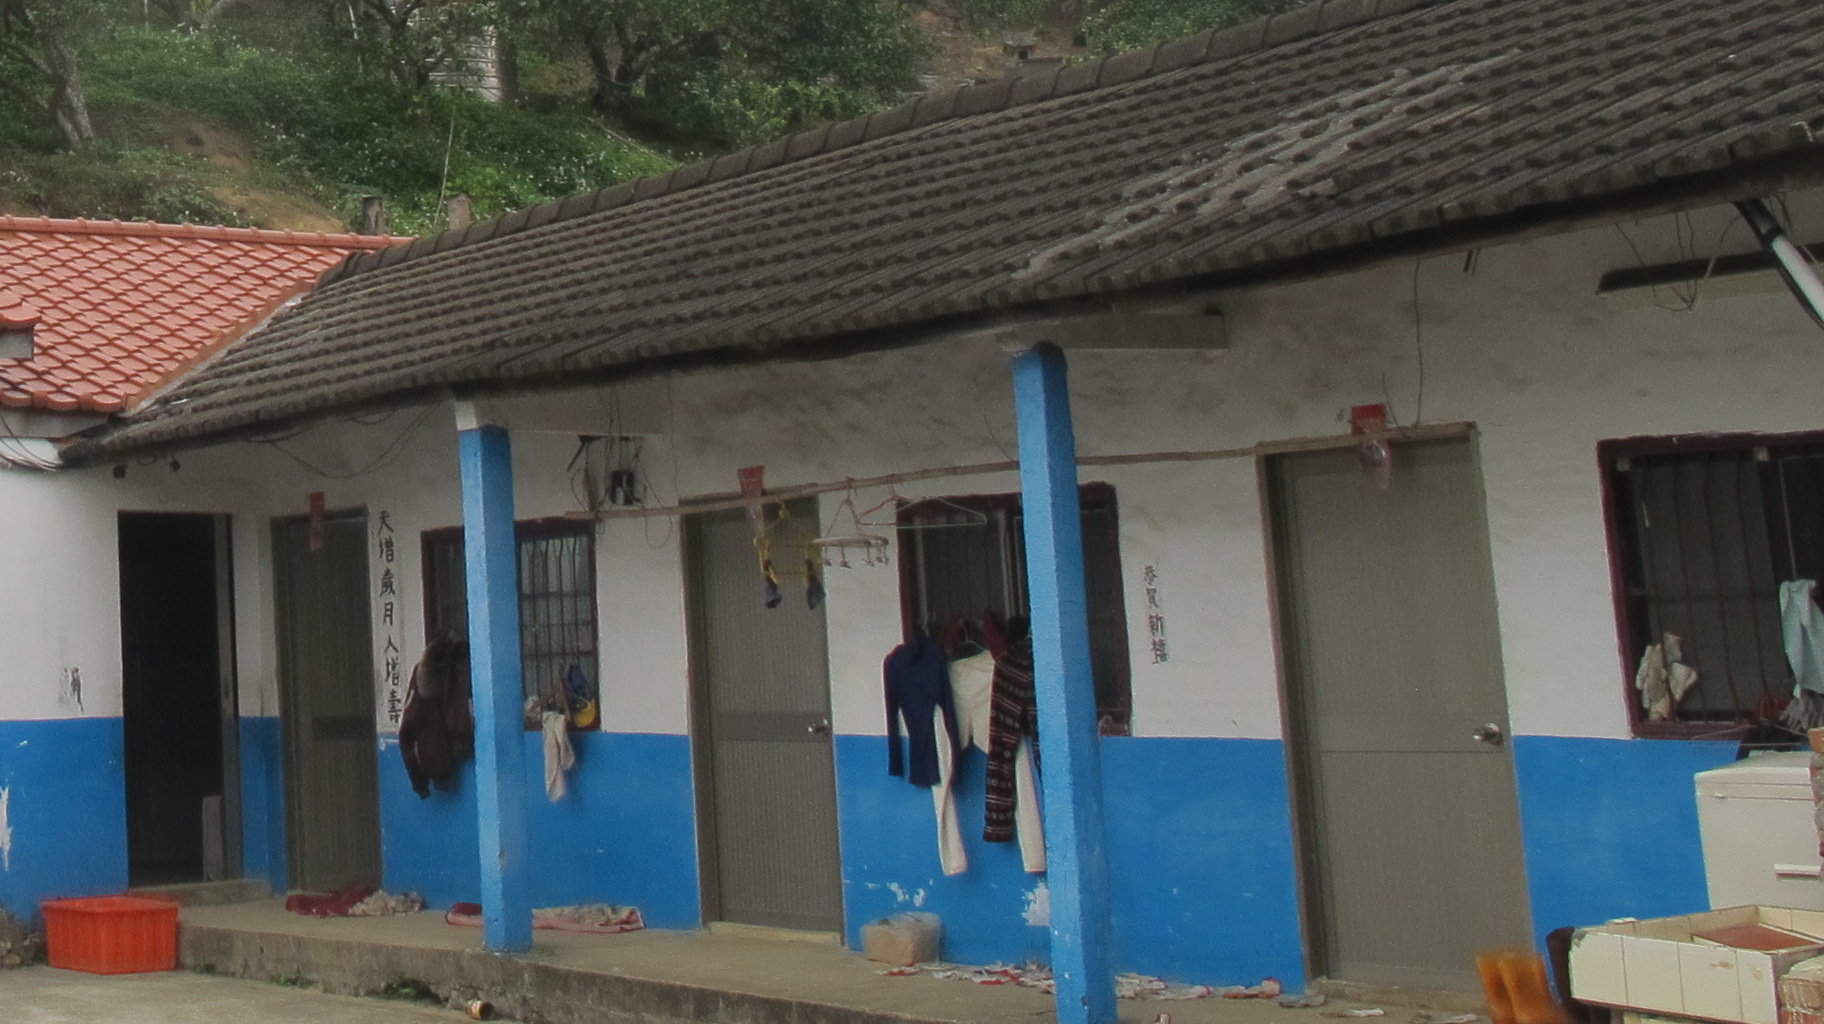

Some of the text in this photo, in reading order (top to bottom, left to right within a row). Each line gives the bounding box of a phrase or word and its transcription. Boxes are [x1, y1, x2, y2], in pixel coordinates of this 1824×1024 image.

[377, 509, 403, 724] 天增歲月人增壽
[1143, 564, 1168, 665] 恭賀新禧
